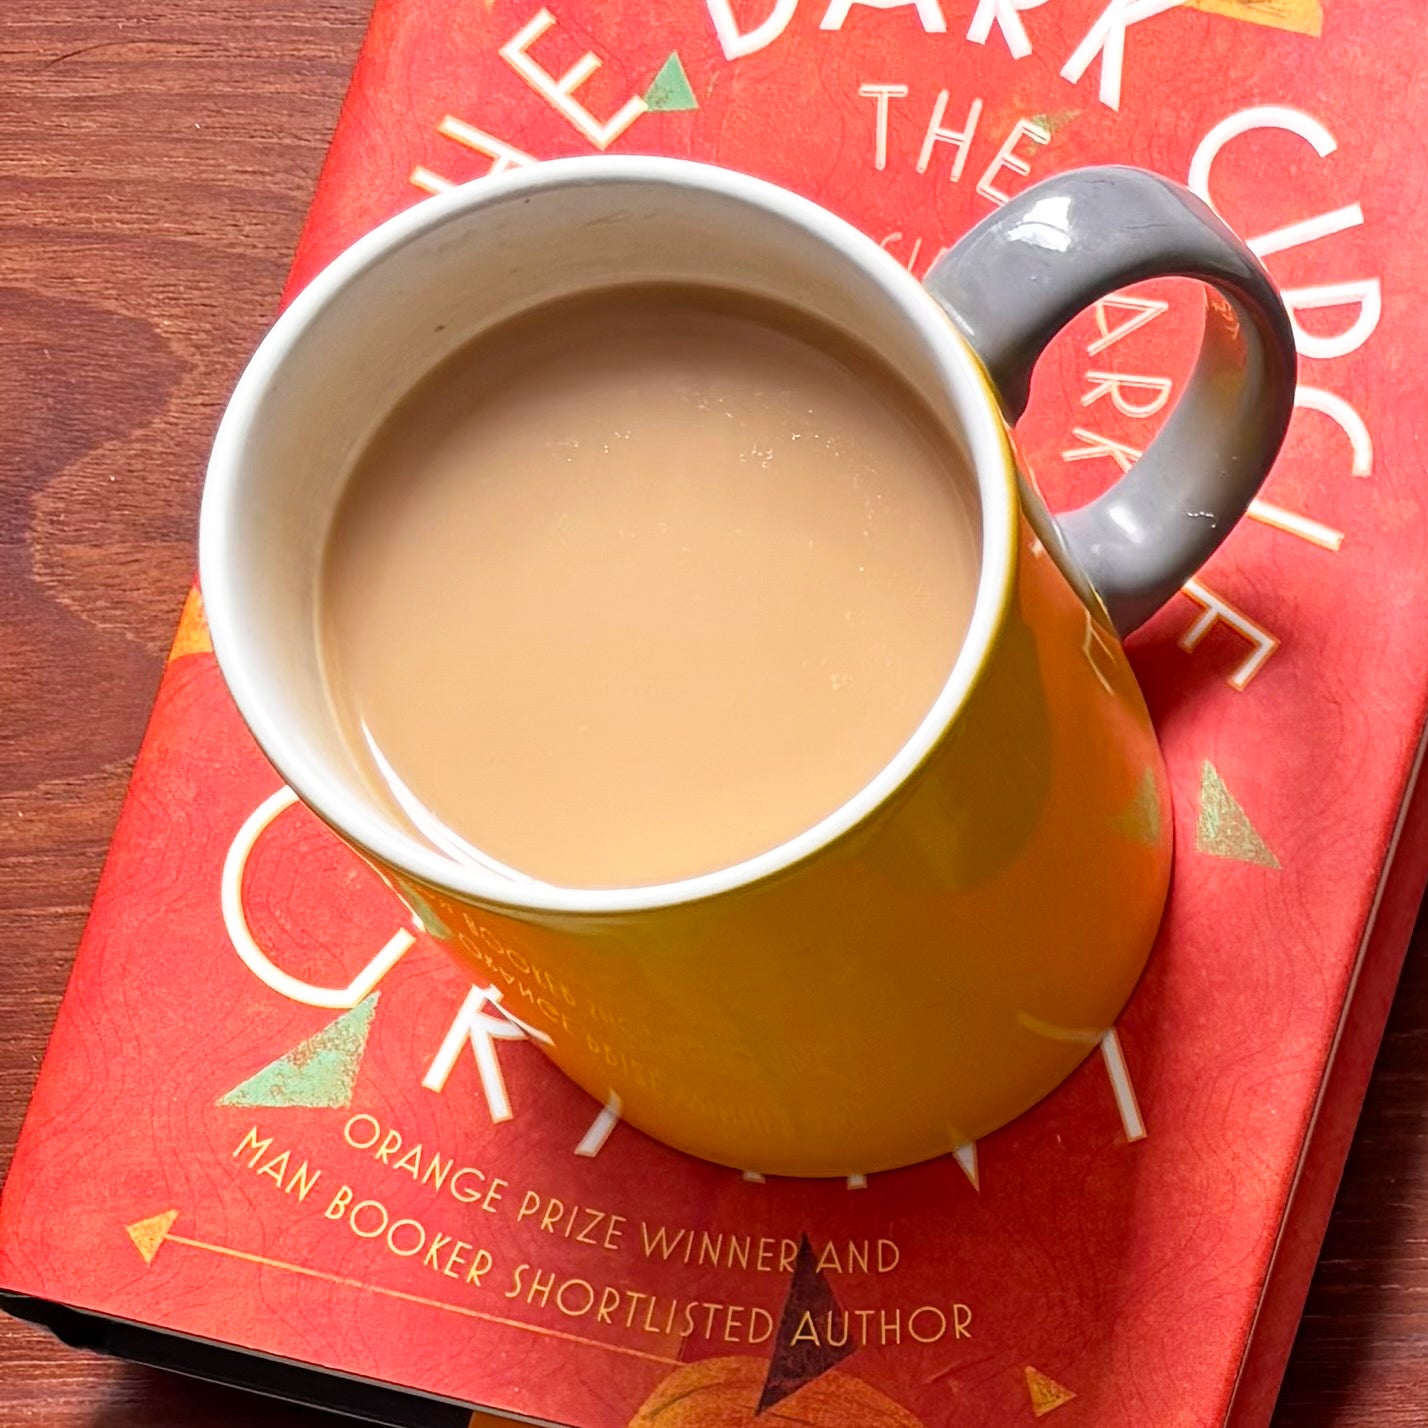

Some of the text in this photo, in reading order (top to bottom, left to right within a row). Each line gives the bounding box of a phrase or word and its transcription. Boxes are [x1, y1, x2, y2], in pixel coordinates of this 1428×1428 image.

[409, 7, 649, 196] HE
[858, 84, 1052, 207] THE
[1061, 294, 1174, 475] ARK
[232, 1126, 974, 1347] MAN BOOKER SHORTLISTED AUTHOR
[343, 1112, 900, 1274] ORANGE PRIZE WINNER AND
